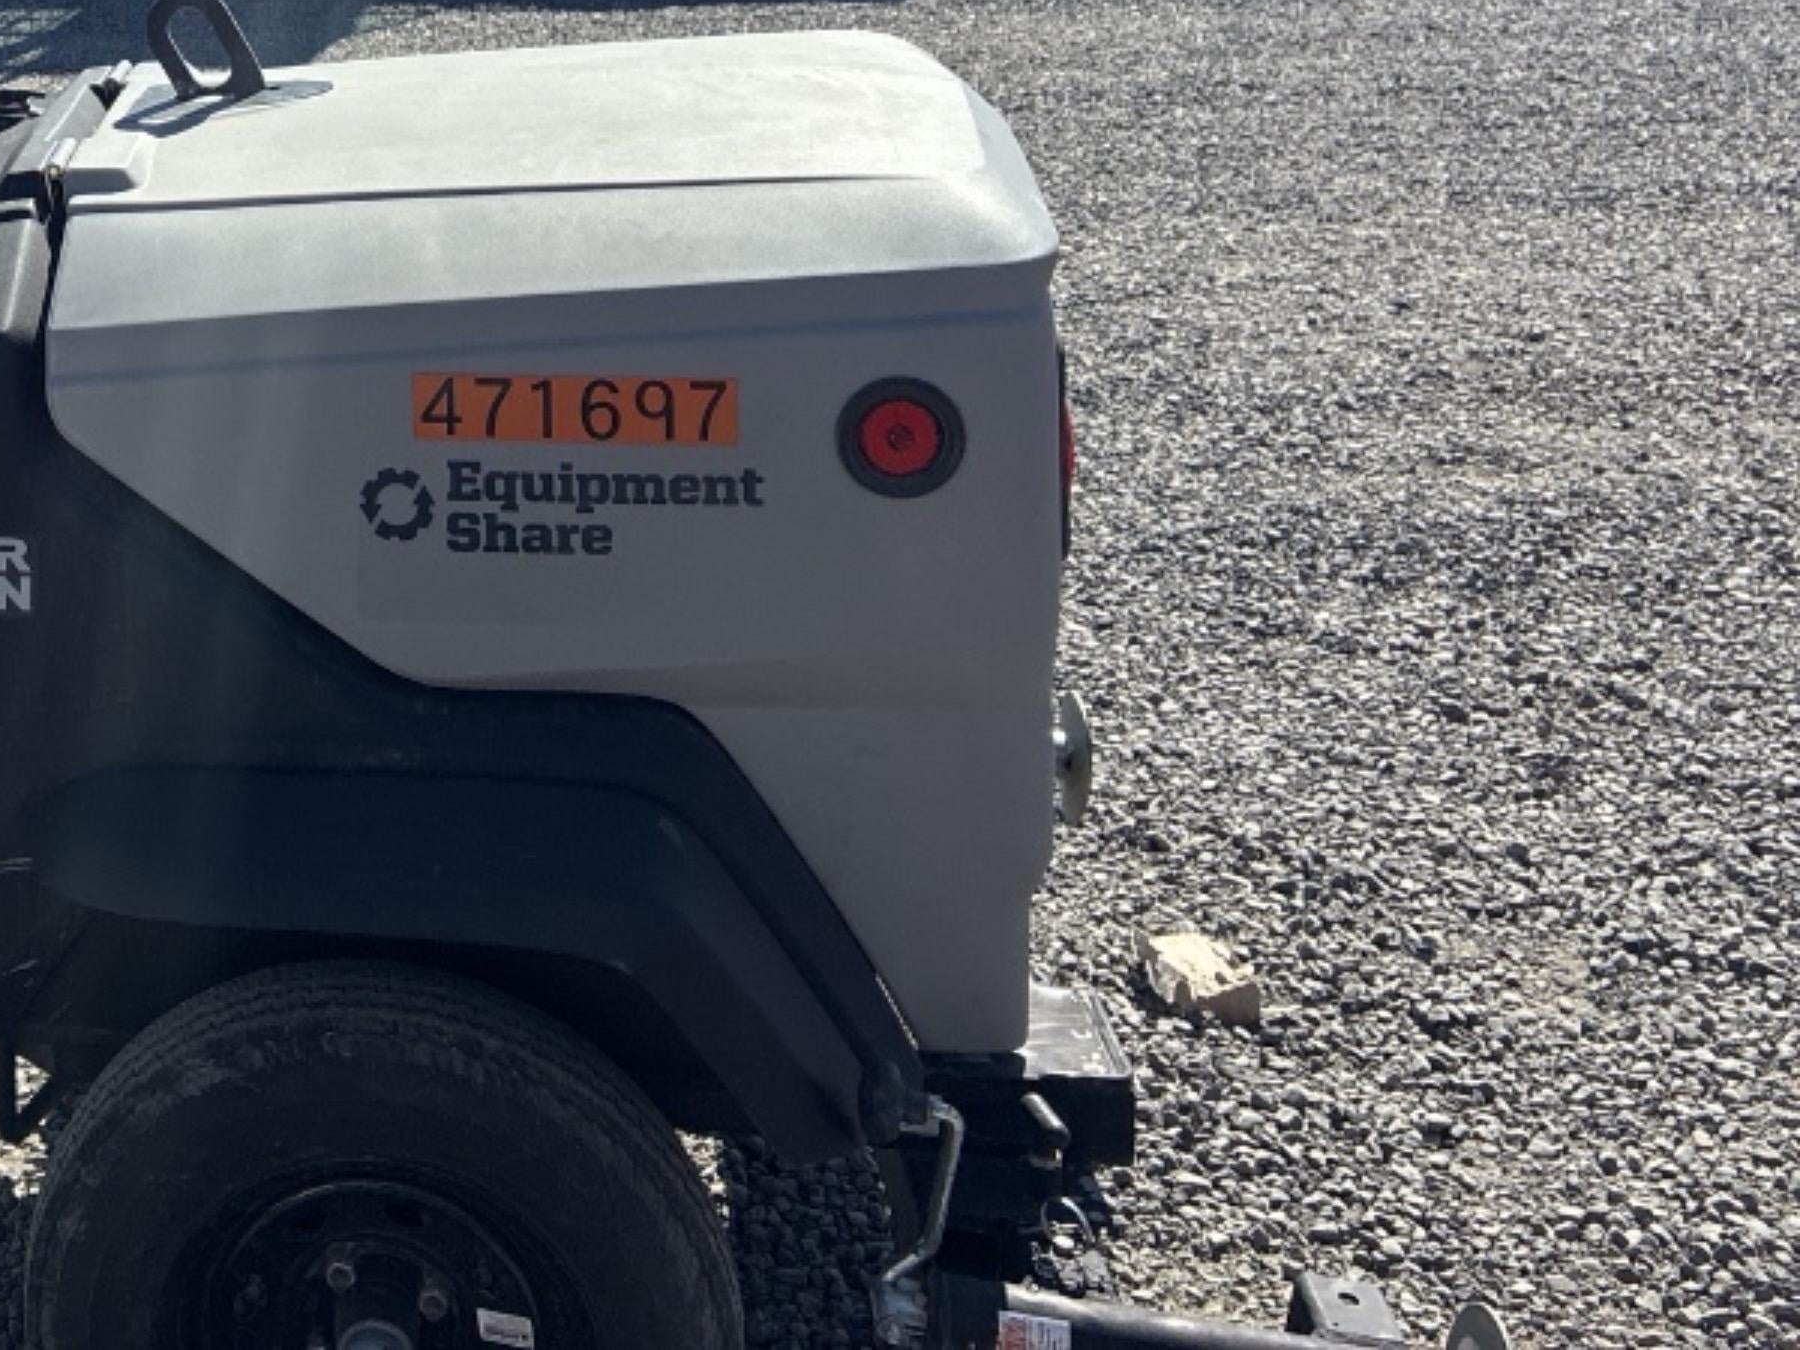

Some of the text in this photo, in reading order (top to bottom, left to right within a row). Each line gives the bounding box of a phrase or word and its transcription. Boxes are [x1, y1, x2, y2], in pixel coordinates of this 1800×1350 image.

[419, 376, 728, 443] 471697
[446, 461, 765, 514] Equipment
[446, 512, 613, 555] Share
